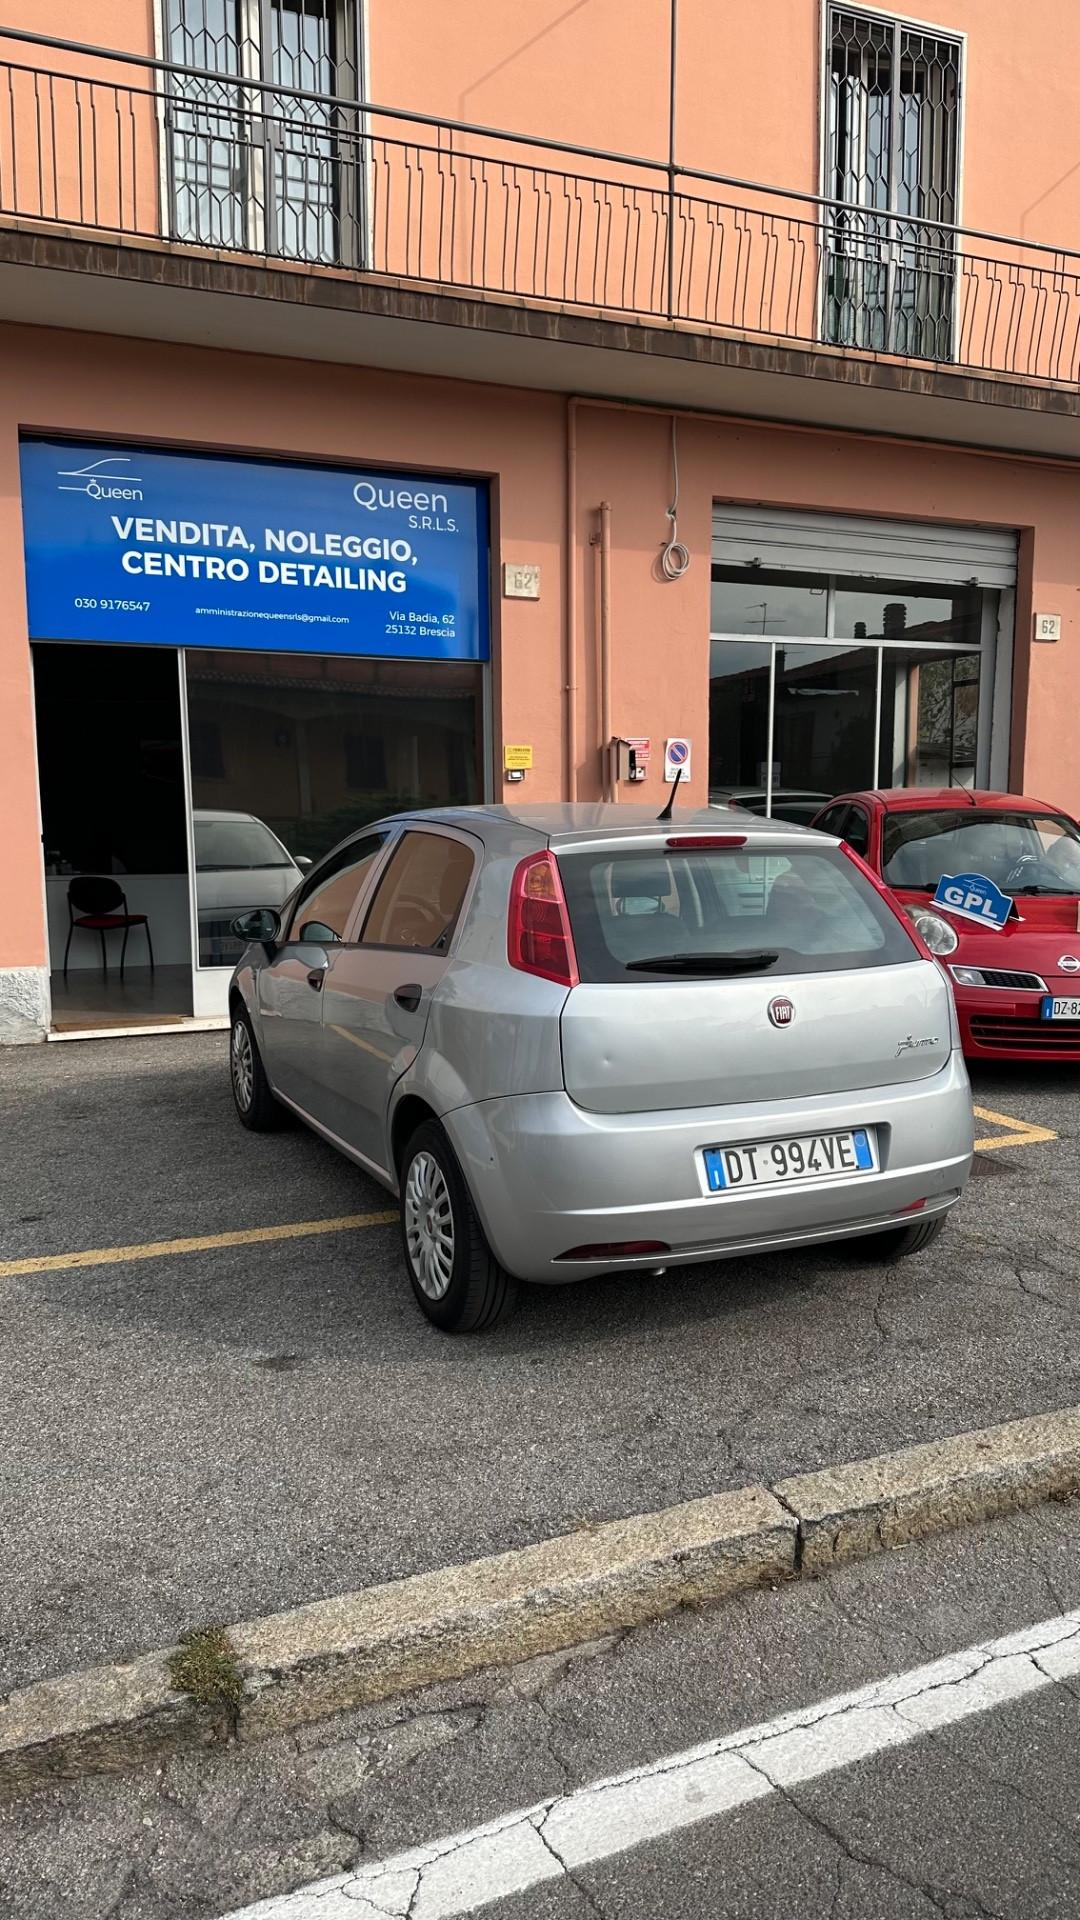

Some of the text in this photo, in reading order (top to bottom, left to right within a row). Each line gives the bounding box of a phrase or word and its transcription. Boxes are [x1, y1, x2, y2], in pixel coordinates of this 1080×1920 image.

[86, 482, 143, 501] Queen
[353, 482, 447, 513] Queen
[408, 515, 460, 533] S.R.L.S.
[111, 515, 418, 566] VENDITA, NOLEGGIO,
[121, 550, 407, 593] CENTRO DETAILING
[74, 598, 151, 612] 030 9176547
[195, 606, 350, 624] amministrazionequeensrls@gmail.com
[389, 610, 455, 625] Via Badia, 62
[385, 624, 456, 638] 25132 Brescia
[1041, 619, 1056, 634] 62
[944, 886, 998, 919] GPL
[775, 1006, 792, 1020] FIAT
[1054, 1001, 1068, 1015] DZ
[724, 1147, 758, 1183] DT
[770, 1135, 855, 1176] 994VE
